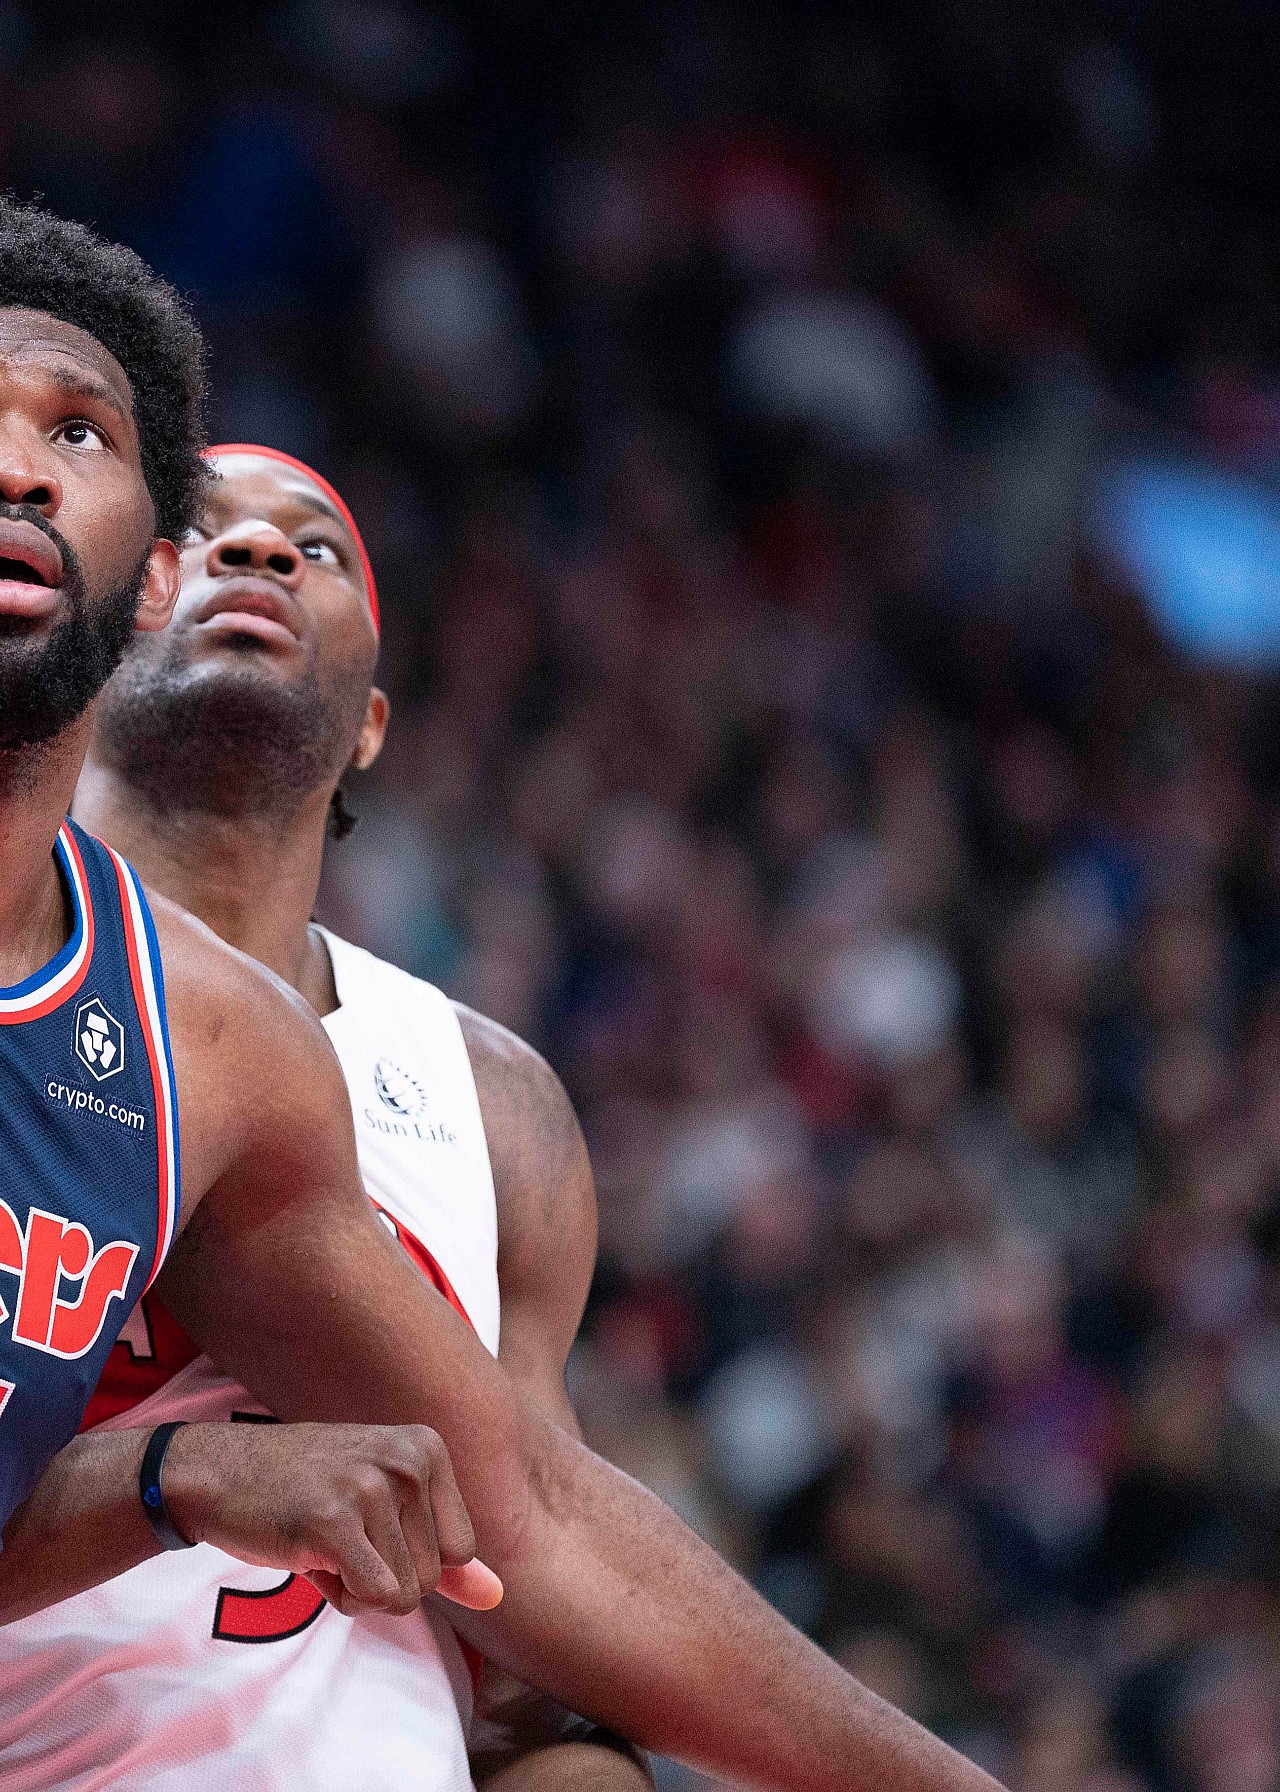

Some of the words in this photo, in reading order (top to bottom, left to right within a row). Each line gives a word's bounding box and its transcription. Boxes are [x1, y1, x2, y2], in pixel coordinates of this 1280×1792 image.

[47, 1081, 145, 1131] crypto.com
[364, 1108, 408, 1136] Sun
[413, 1123, 457, 1143] Life
